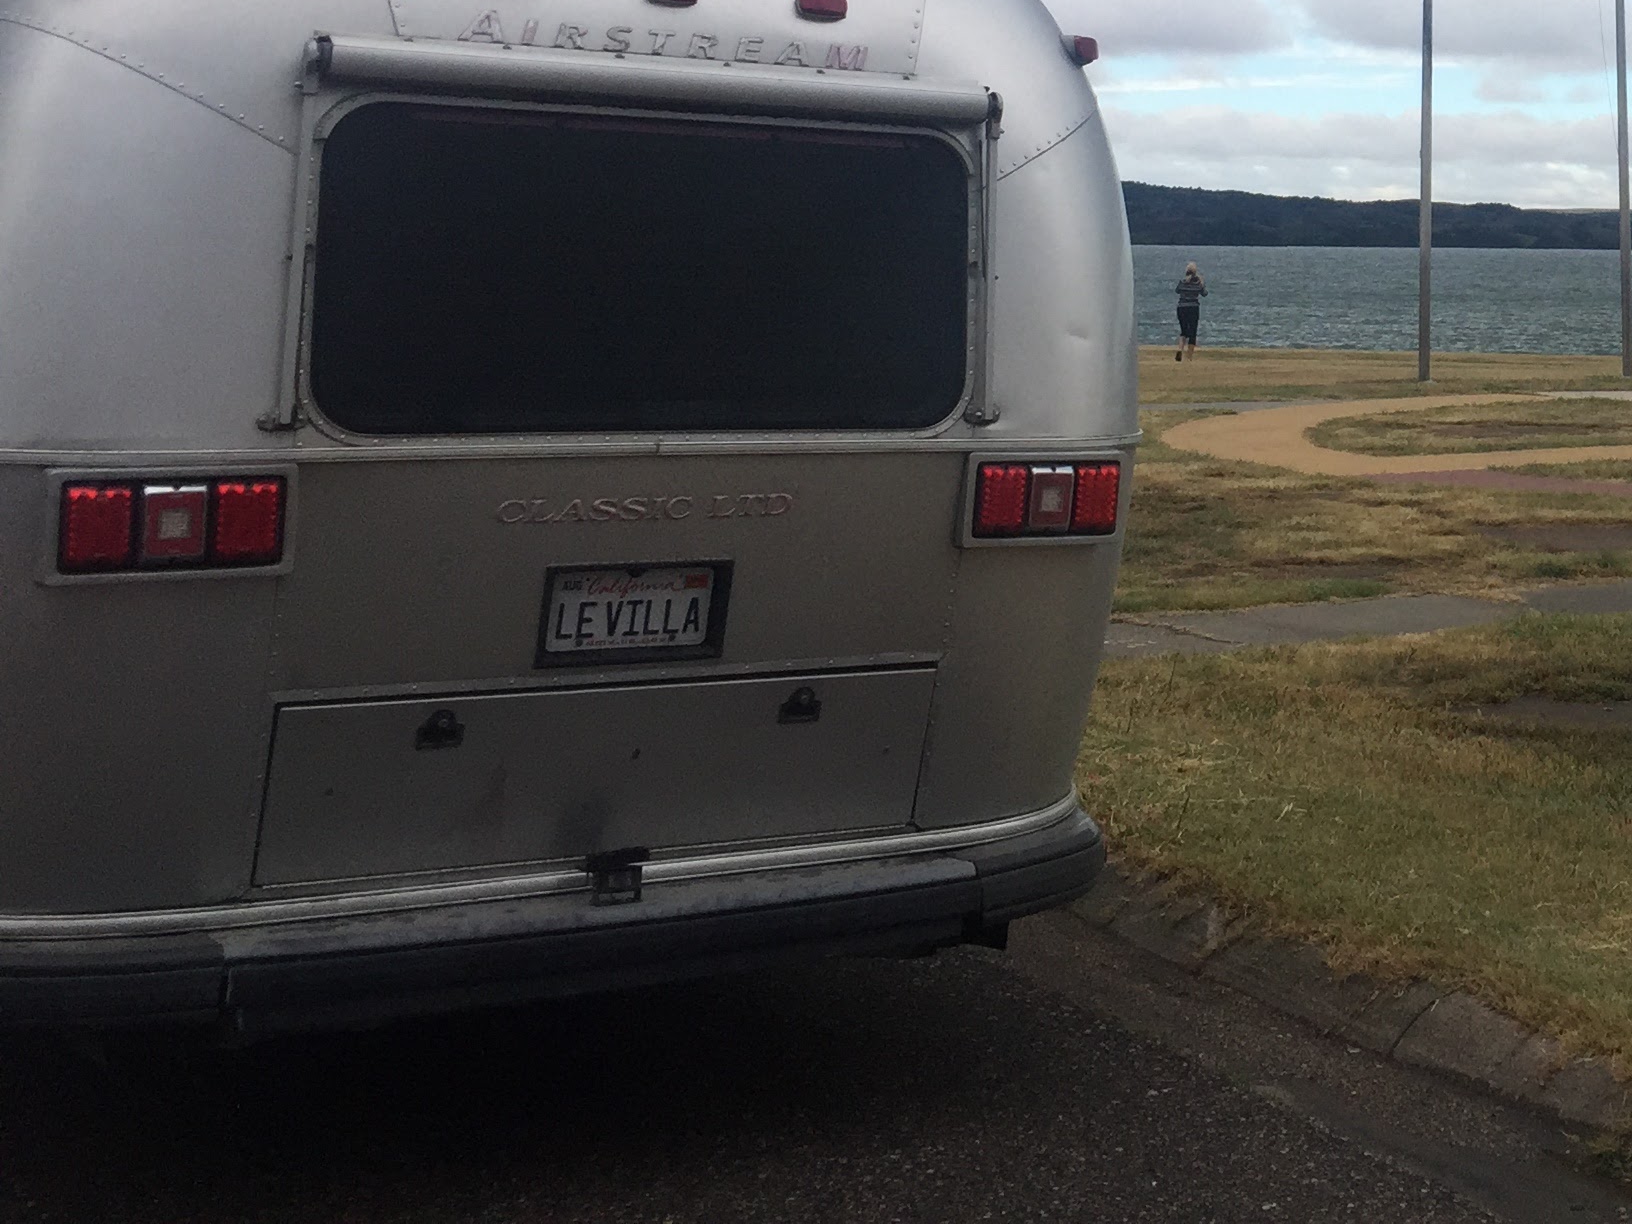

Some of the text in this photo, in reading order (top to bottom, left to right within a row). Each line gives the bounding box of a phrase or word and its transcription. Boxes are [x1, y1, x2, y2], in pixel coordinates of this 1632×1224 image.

[458, 9, 868, 71] AIRSTREAM
[497, 493, 793, 524] CLASSIC LTD
